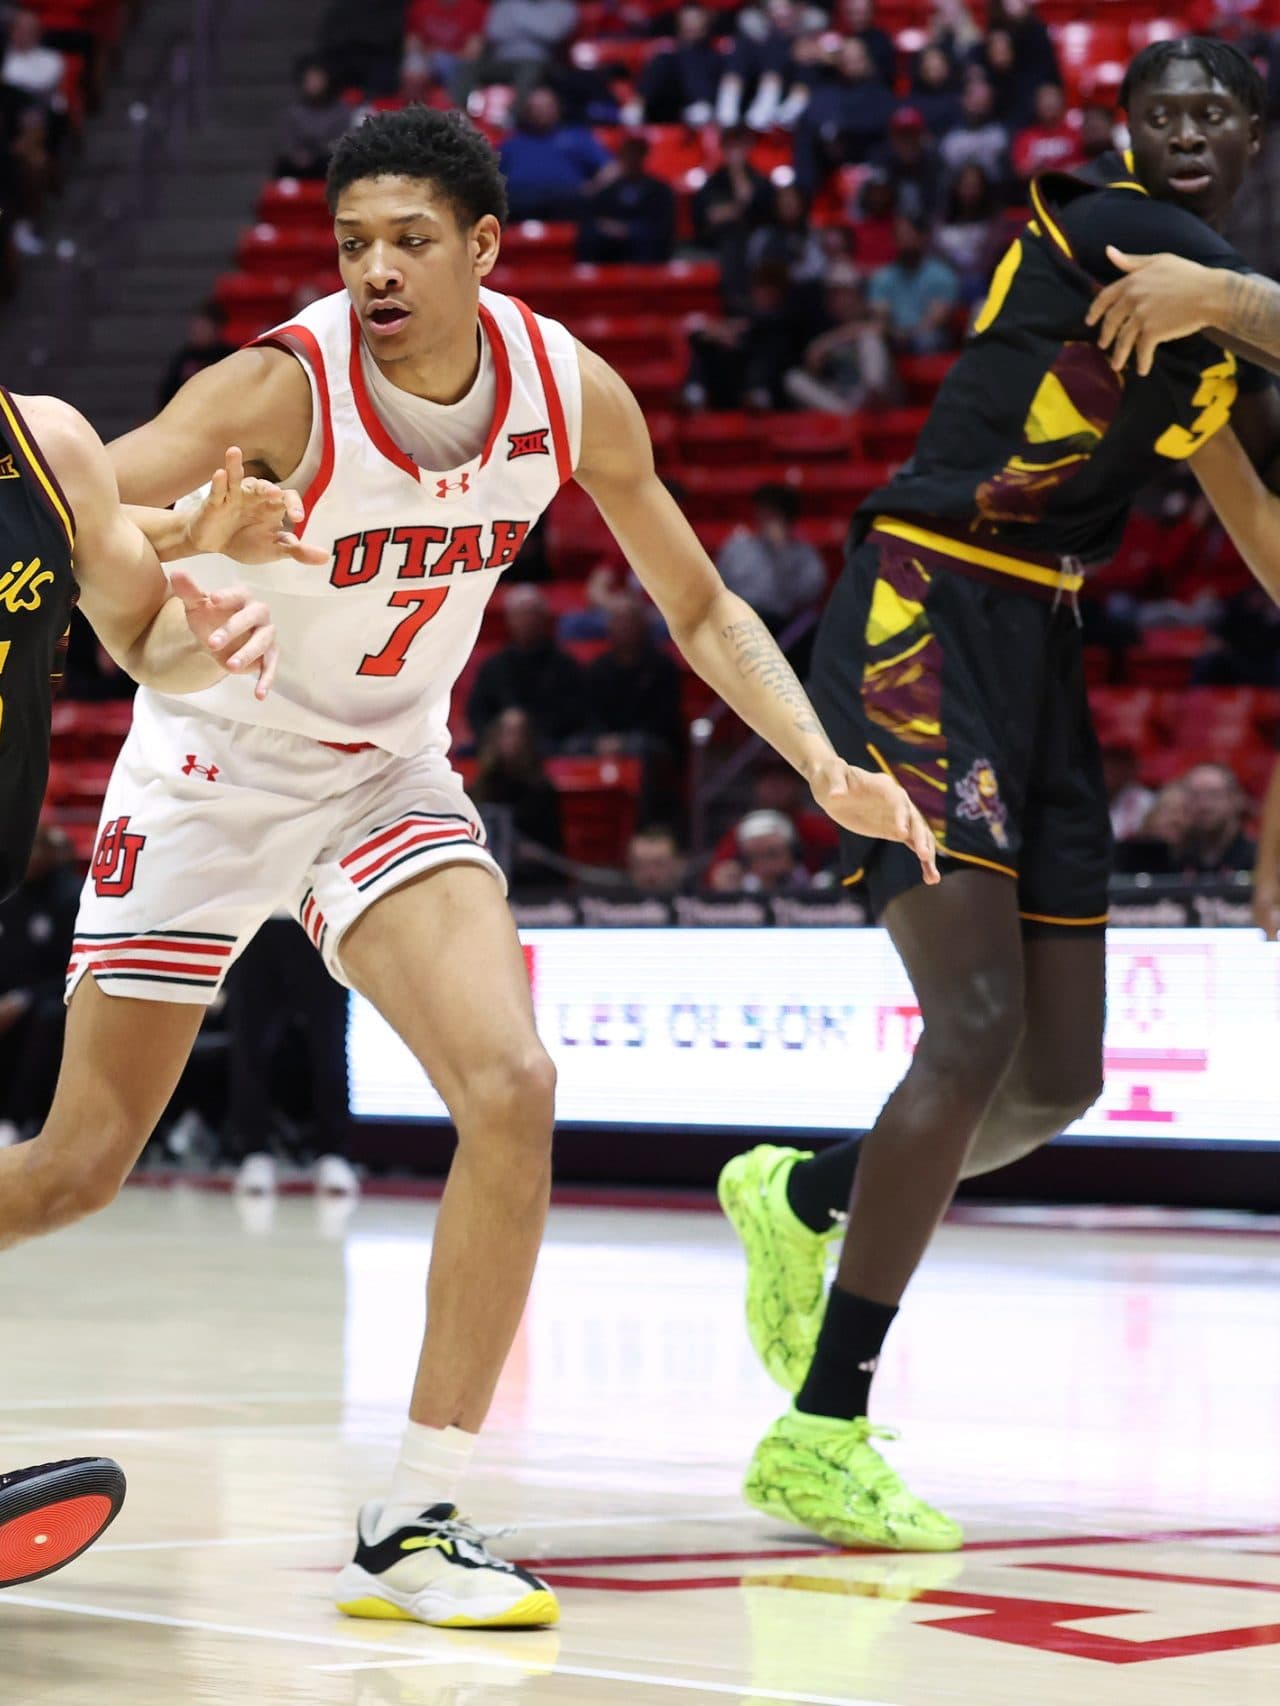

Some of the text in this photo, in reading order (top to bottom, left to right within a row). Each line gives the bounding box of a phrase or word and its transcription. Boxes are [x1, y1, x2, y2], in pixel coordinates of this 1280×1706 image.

[329, 520, 531, 589] UTAH
[356, 585, 451, 677] 7
[558, 1002, 644, 1047] LES
